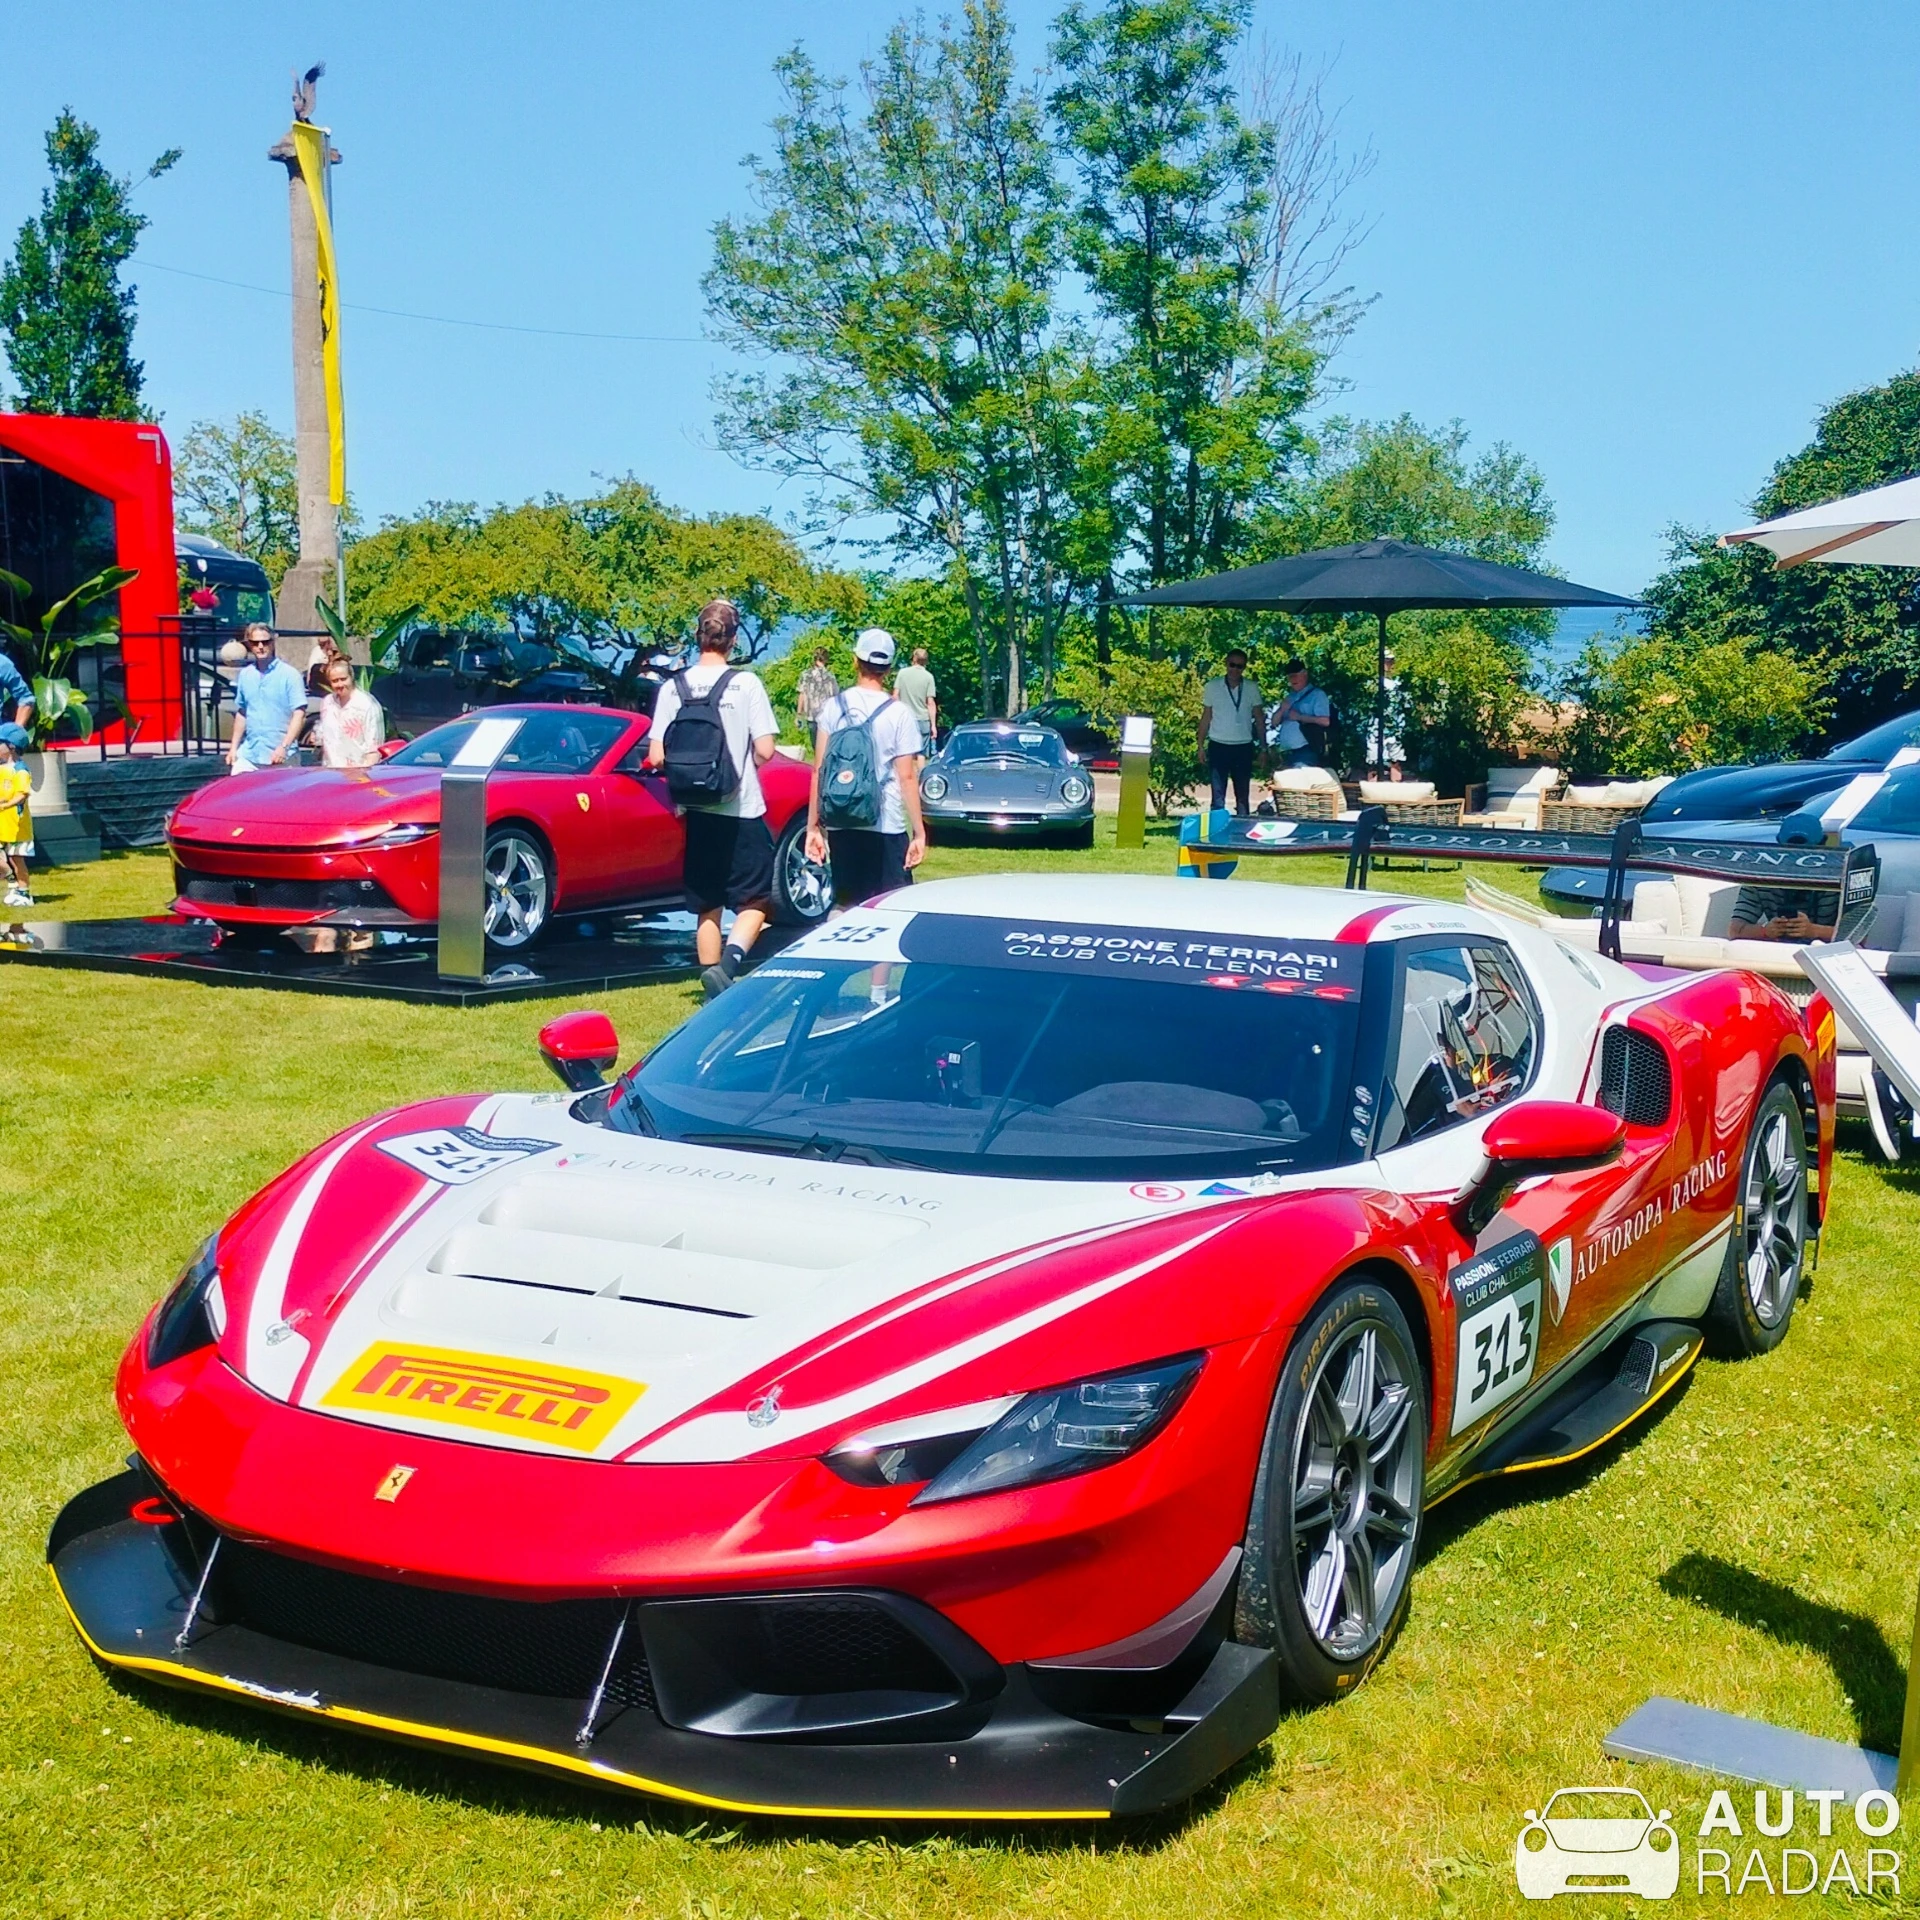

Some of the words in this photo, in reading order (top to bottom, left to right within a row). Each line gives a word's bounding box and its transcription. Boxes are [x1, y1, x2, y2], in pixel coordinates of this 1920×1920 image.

[1651, 846, 1828, 868] ACING
[818, 925, 891, 943] 313
[1004, 932, 1175, 953] PASSIONE
[1186, 943, 1338, 969] FERRARI
[1006, 944, 1097, 961] CLUB
[1106, 950, 1324, 982] CHALLENGE
[598, 1158, 777, 1186] AUTOROPA
[799, 1180, 943, 1212] RACING
[1574, 1196, 1663, 1285] AUTOROPA
[1671, 1150, 1728, 1214] RACING
[1454, 1258, 1500, 1291] PASSIONE
[1499, 1238, 1536, 1267] FERRARI
[1465, 1284, 1488, 1308] CLUB
[1488, 1257, 1535, 1295] CHALLENGE
[1301, 1301, 1348, 1391] PIRELLI
[1471, 1300, 1535, 1404] 313
[352, 1354, 611, 1430] PIRELLI
